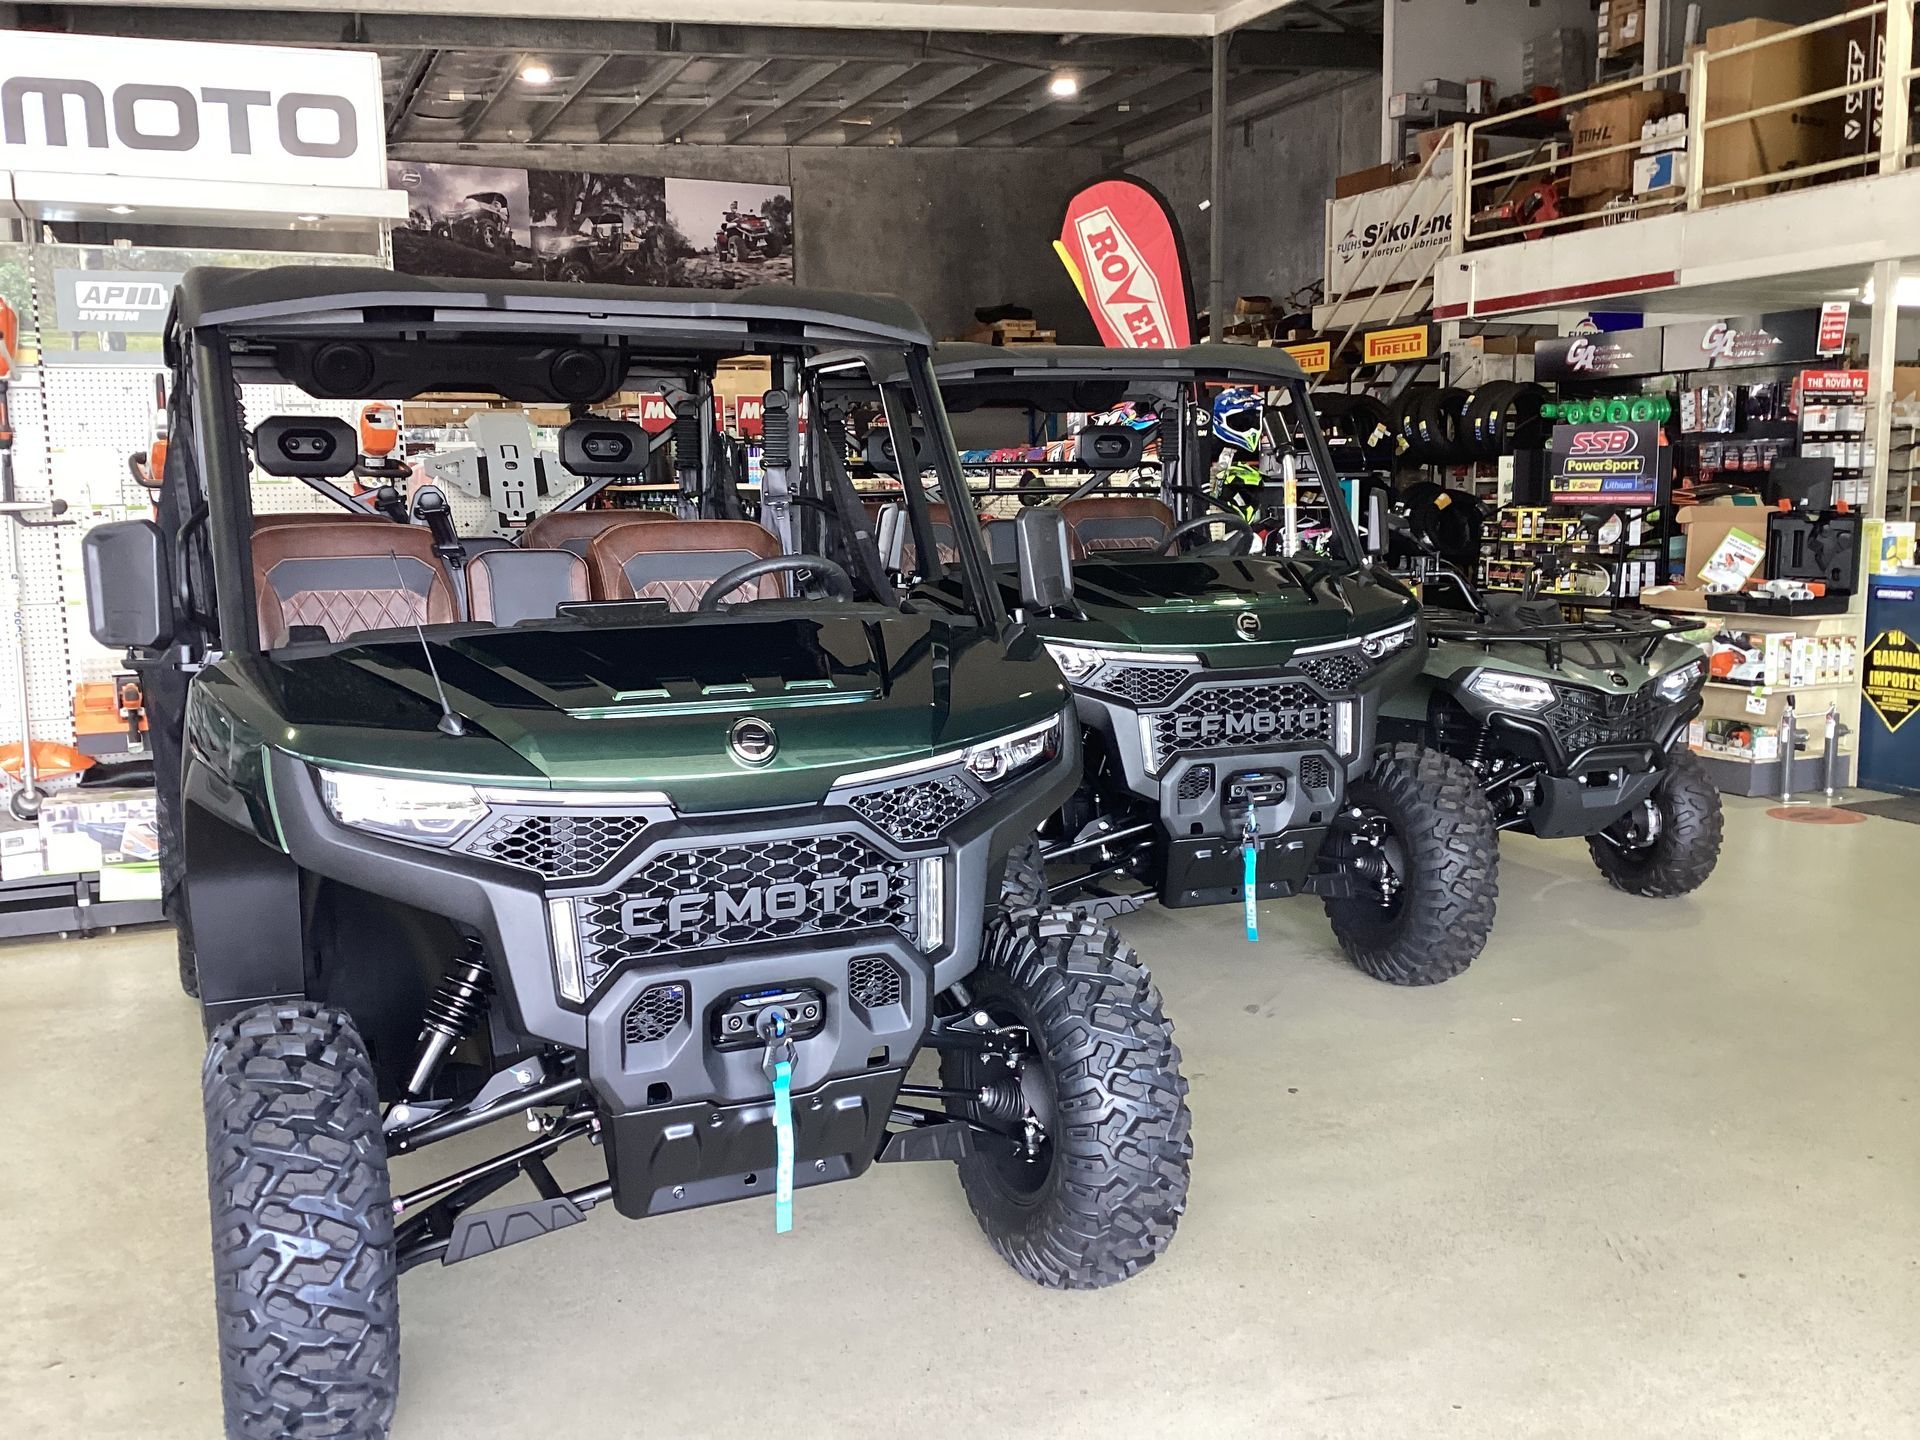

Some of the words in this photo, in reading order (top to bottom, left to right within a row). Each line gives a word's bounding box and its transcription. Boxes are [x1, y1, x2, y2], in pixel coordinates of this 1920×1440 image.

[1, 76, 358, 158] MOTO
[1578, 126, 1612, 145] STIHL
[1087, 225, 1165, 348] ROVER
[78, 310, 140, 321] SYSTEM
[1370, 333, 1422, 357] PIRELLI
[1808, 378, 1823, 387] THE
[1825, 378, 1851, 387] ROVER
[1853, 378, 1863, 387] RZ
[1570, 431, 1629, 454] SSB
[1567, 459, 1639, 473] PowerSport
[1604, 481, 1633, 490] Lithium
[1872, 650, 1920, 671] BANANA
[1869, 671, 1920, 691] IMPORTS
[1176, 708, 1321, 738] CFMOTO
[620, 872, 889, 936] CFMOTO
